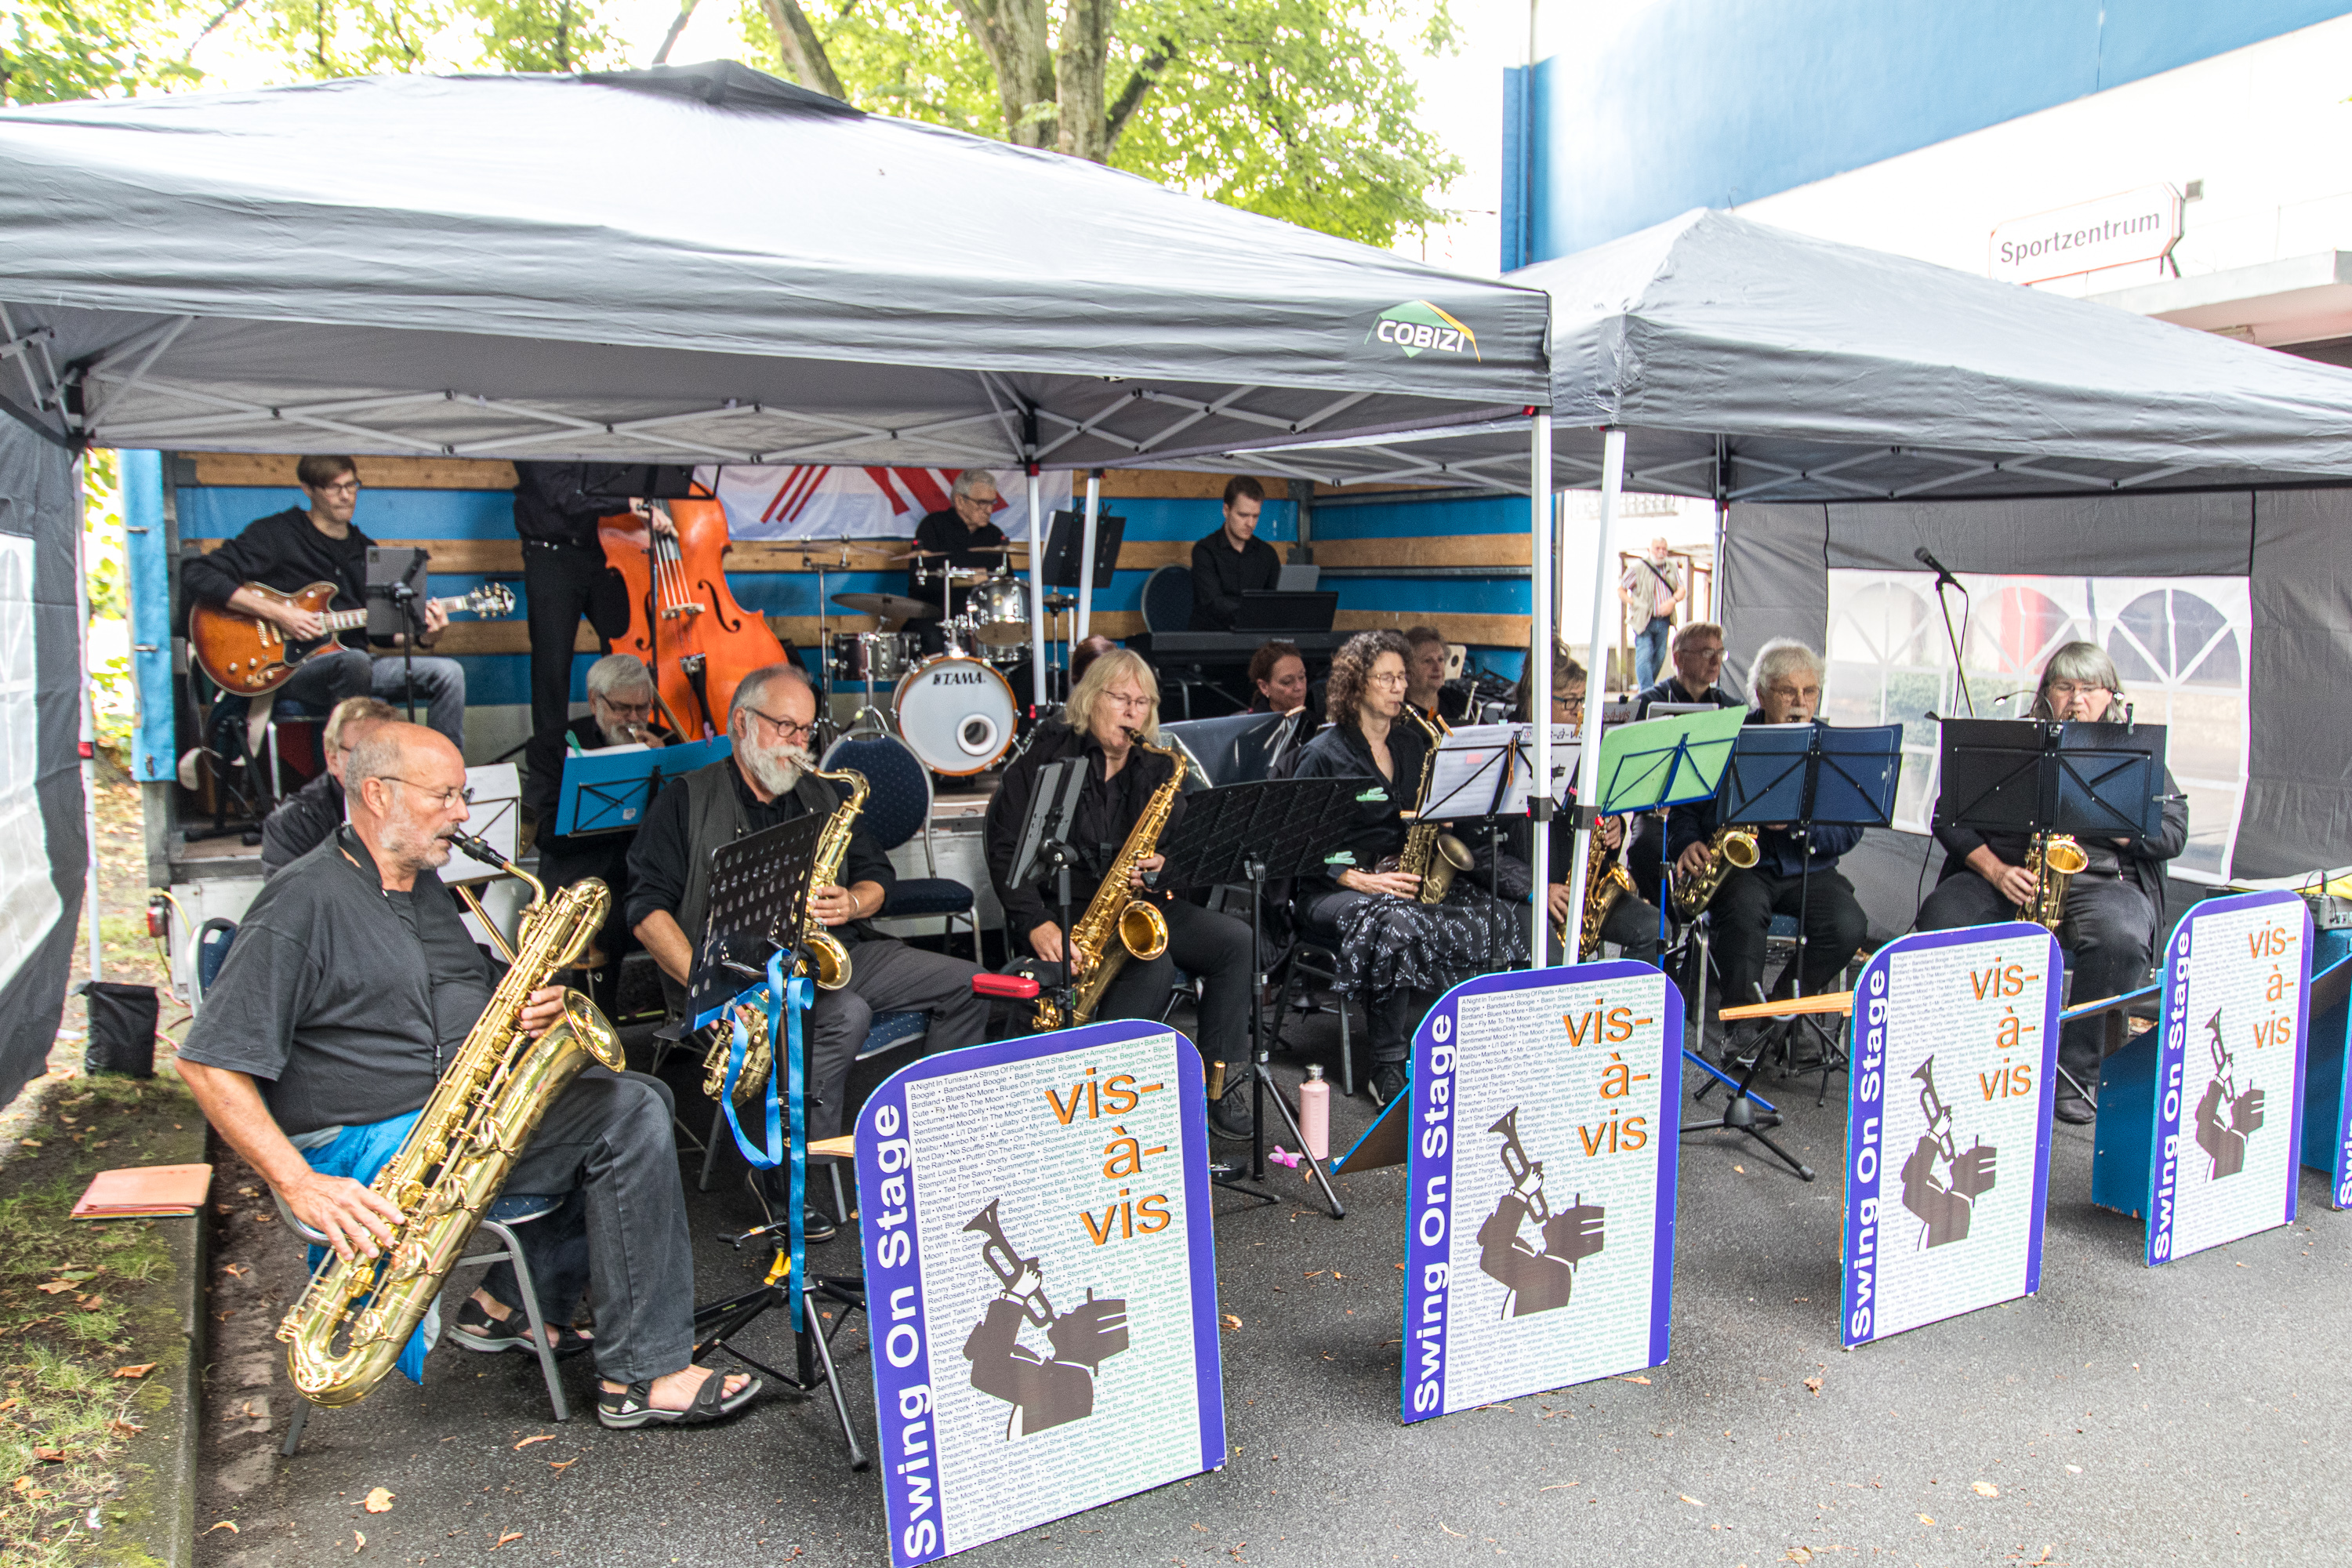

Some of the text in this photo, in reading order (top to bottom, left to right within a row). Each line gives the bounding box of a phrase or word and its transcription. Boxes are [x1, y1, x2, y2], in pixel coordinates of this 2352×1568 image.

[2001, 212, 2160, 266] Sportzentrum
[1377, 320, 1465, 353] COBIZI
[944, 672, 983, 684] TAMA
[2249, 920, 2296, 959] vis-
[1970, 956, 2038, 1000] vis-
[2266, 964, 2294, 1002] à-
[1563, 999, 1653, 1047] vis-
[1997, 1006, 2035, 1049] à-
[2253, 1011, 2290, 1049] vis
[910, 1091, 935, 1100] Boogie
[944, 1080, 981, 1094] Bandstand
[983, 1076, 1007, 1086] Boogie
[1015, 1071, 1034, 1080] Basin
[1036, 1066, 1056, 1075] Street
[1120, 1050, 1146, 1059] Beguine
[943, 1075, 969, 1084] Tunisia
[1010, 1063, 1031, 1072] Pearls
[1065, 1051, 1085, 1061] Sweet
[1090, 1046, 1120, 1056] American
[1120, 1041, 1139, 1050] Patrol
[1143, 1037, 1160, 1046] Back
[1011, 1088, 1032, 1098] Gettin'
[1130, 1065, 1146, 1074] Wind
[1600, 1053, 1650, 1099] à-
[1979, 1058, 2031, 1102] vis
[911, 1098, 941, 1109] Birdland
[946, 1094, 966, 1102] Blues
[1032, 1076, 1056, 1085] Parade
[913, 1116, 946, 1127] Nocturne
[949, 1111, 967, 1120] Hello
[1006, 1099, 1022, 1108] High
[1044, 1068, 1165, 1126] vis-
[2154, 932, 2190, 1259] Swing On Stage
[913, 1122, 955, 1136] Sentimental
[956, 1117, 976, 1127] Mood
[1004, 1108, 1024, 1117] Mood
[1029, 1103, 1051, 1112] Jersey
[914, 1133, 949, 1145] Woodside
[967, 1123, 989, 1134] Darlin'
[996, 1118, 1020, 1127] Lullaby
[915, 1144, 938, 1153] Malibu
[943, 1138, 969, 1148] Mambo
[1001, 1125, 1025, 1135] Casual
[1160, 1094, 1176, 1102] Night
[916, 1154, 931, 1163] And
[961, 1143, 985, 1152] Scuffle
[985, 1138, 1009, 1148] Shuffle
[1098, 1114, 1117, 1123] Street
[1121, 1107, 1157, 1119] Ornithology
[1577, 1109, 1647, 1157] vis
[1104, 1127, 1167, 1179] à-
[1852, 970, 1890, 1338] Swing On Stage
[1080, 1189, 1171, 1247] vis
[1414, 1014, 1457, 1414] Swing On Stage
[875, 1104, 937, 1558] Swing On Stage
